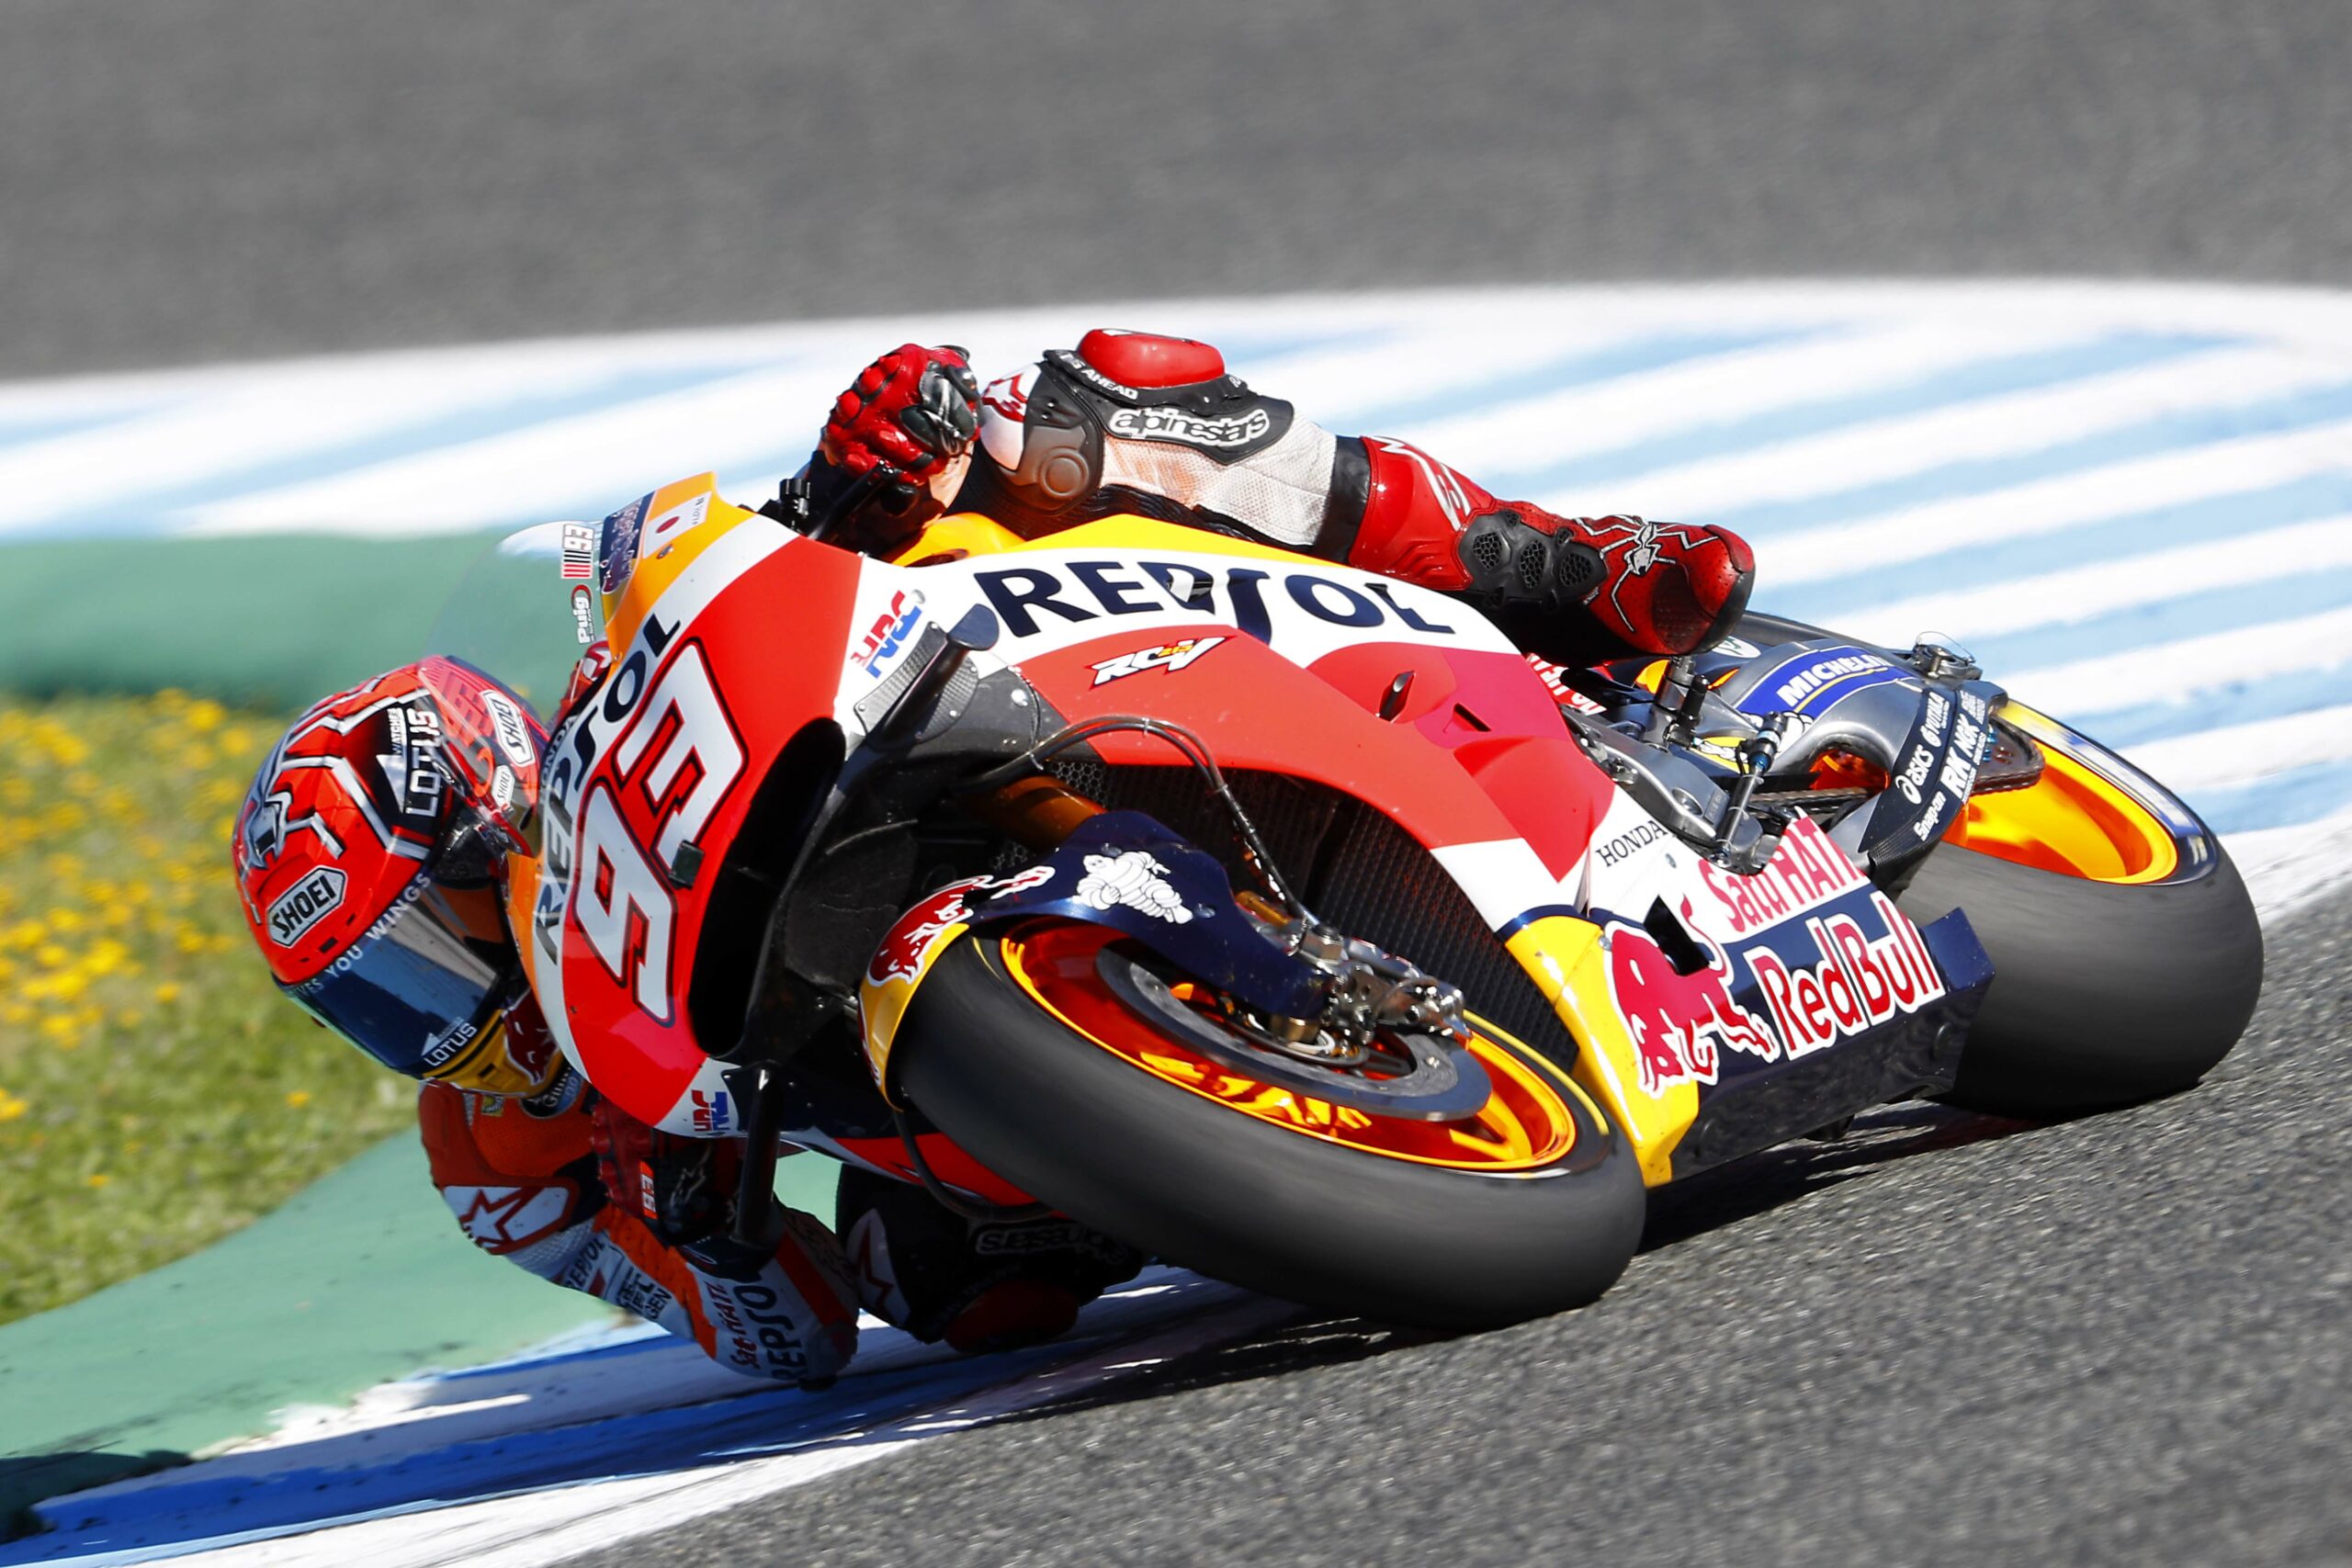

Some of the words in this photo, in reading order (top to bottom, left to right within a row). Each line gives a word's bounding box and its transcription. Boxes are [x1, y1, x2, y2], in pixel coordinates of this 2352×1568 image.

[1084, 367, 1138, 400] AHEAD
[563, 524, 594, 551] 93
[572, 595, 592, 644] Puig
[973, 560, 1455, 645] REPSOL
[851, 590, 922, 680] HRC
[1776, 649, 1889, 707] MICHELIN
[388, 707, 402, 754] WATCHES
[493, 698, 526, 761] SHOEI
[1953, 711, 1981, 755] NGK
[406, 707, 443, 818] LOTUS
[493, 770, 512, 803] SHOEI
[1909, 745, 1935, 789] asics
[1941, 747, 1972, 799] RK
[533, 614, 682, 965] REPSOL
[576, 641, 744, 1024] 93
[1913, 792, 1946, 840] Snap-on
[1596, 819, 1669, 869] HONDA
[277, 876, 337, 940] SHOEI
[326, 945, 364, 980] YOU
[366, 873, 432, 942] WINGS
[1746, 919, 1867, 1058] Red
[1835, 894, 1944, 1021] Bull
[424, 1021, 478, 1067] LOTUS
